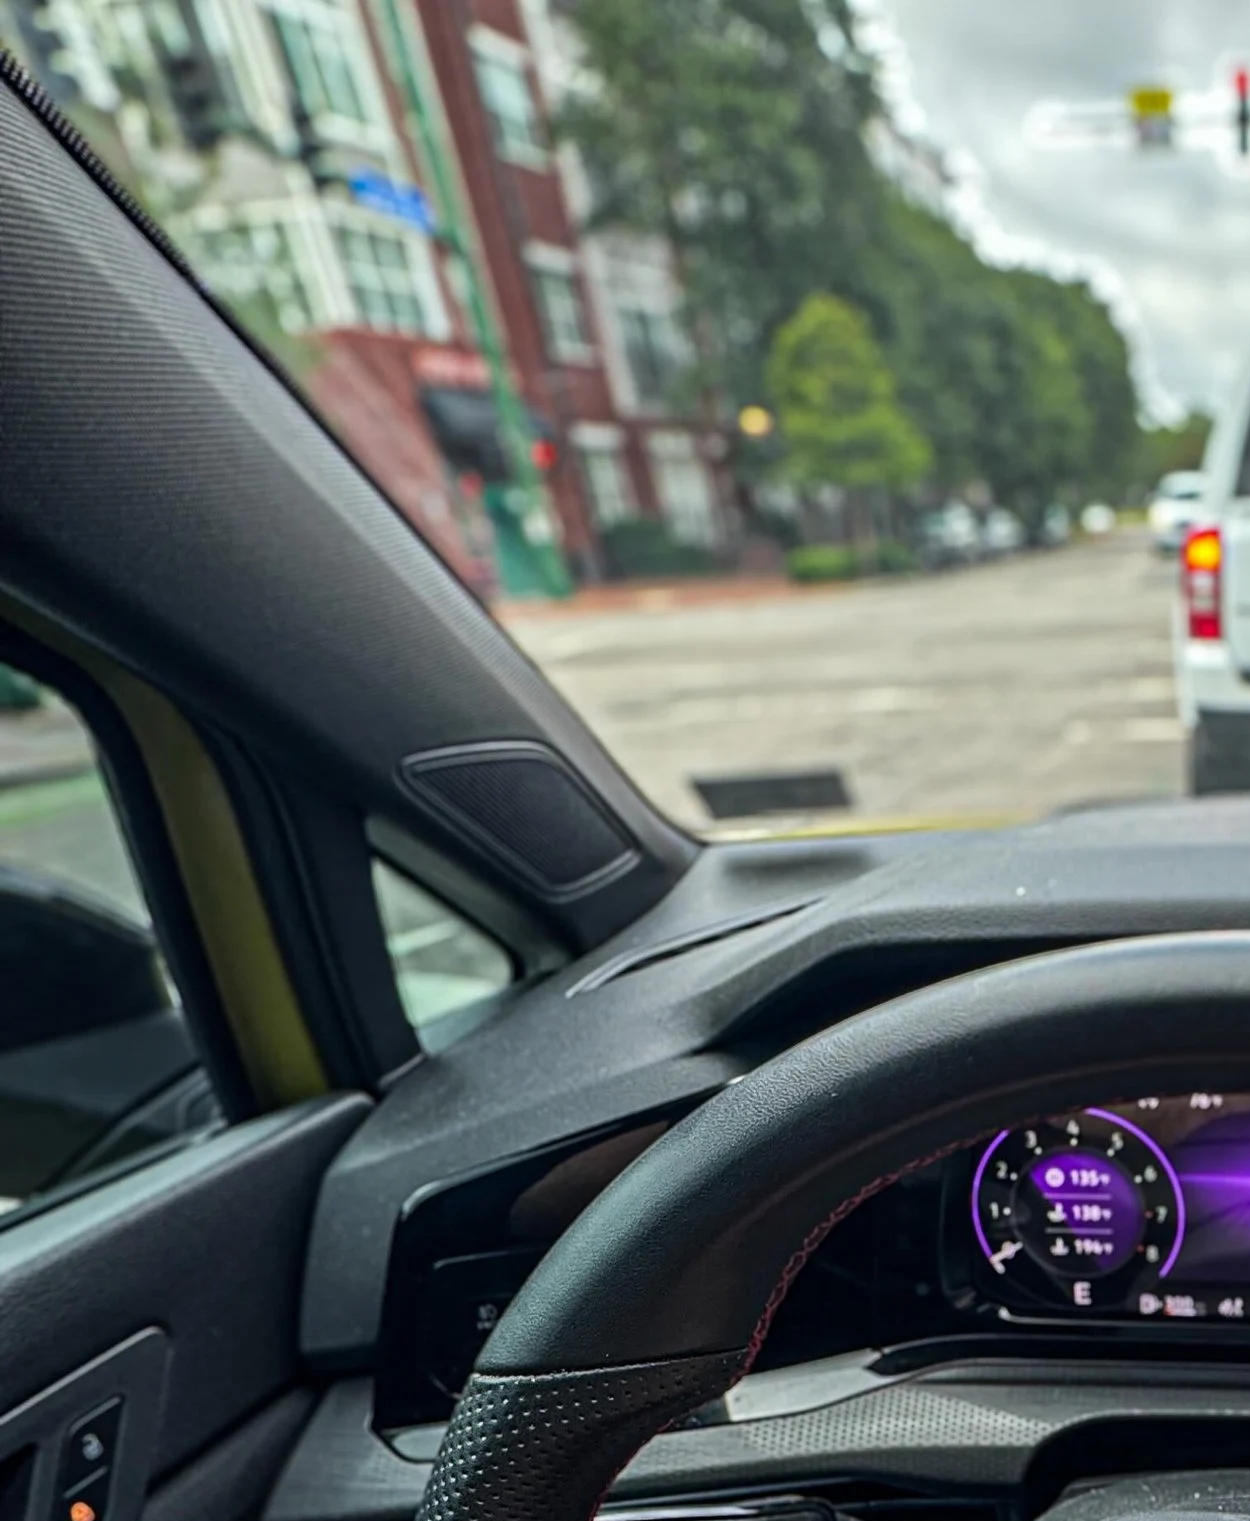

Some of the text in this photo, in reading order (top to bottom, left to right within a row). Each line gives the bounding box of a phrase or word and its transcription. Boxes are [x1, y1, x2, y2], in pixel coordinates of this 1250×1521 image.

[1067, 1120, 1080, 1135] 4
[1025, 1130, 1037, 1148] 3
[1111, 1132, 1124, 1150] 5
[996, 1161, 1008, 1179] 2
[1144, 1165, 1157, 1182] 6
[989, 1202, 999, 1219] 1
[1155, 1205, 1168, 1223] 7
[1146, 1245, 1159, 1263] 8
[1073, 1281, 1092, 1306] E
